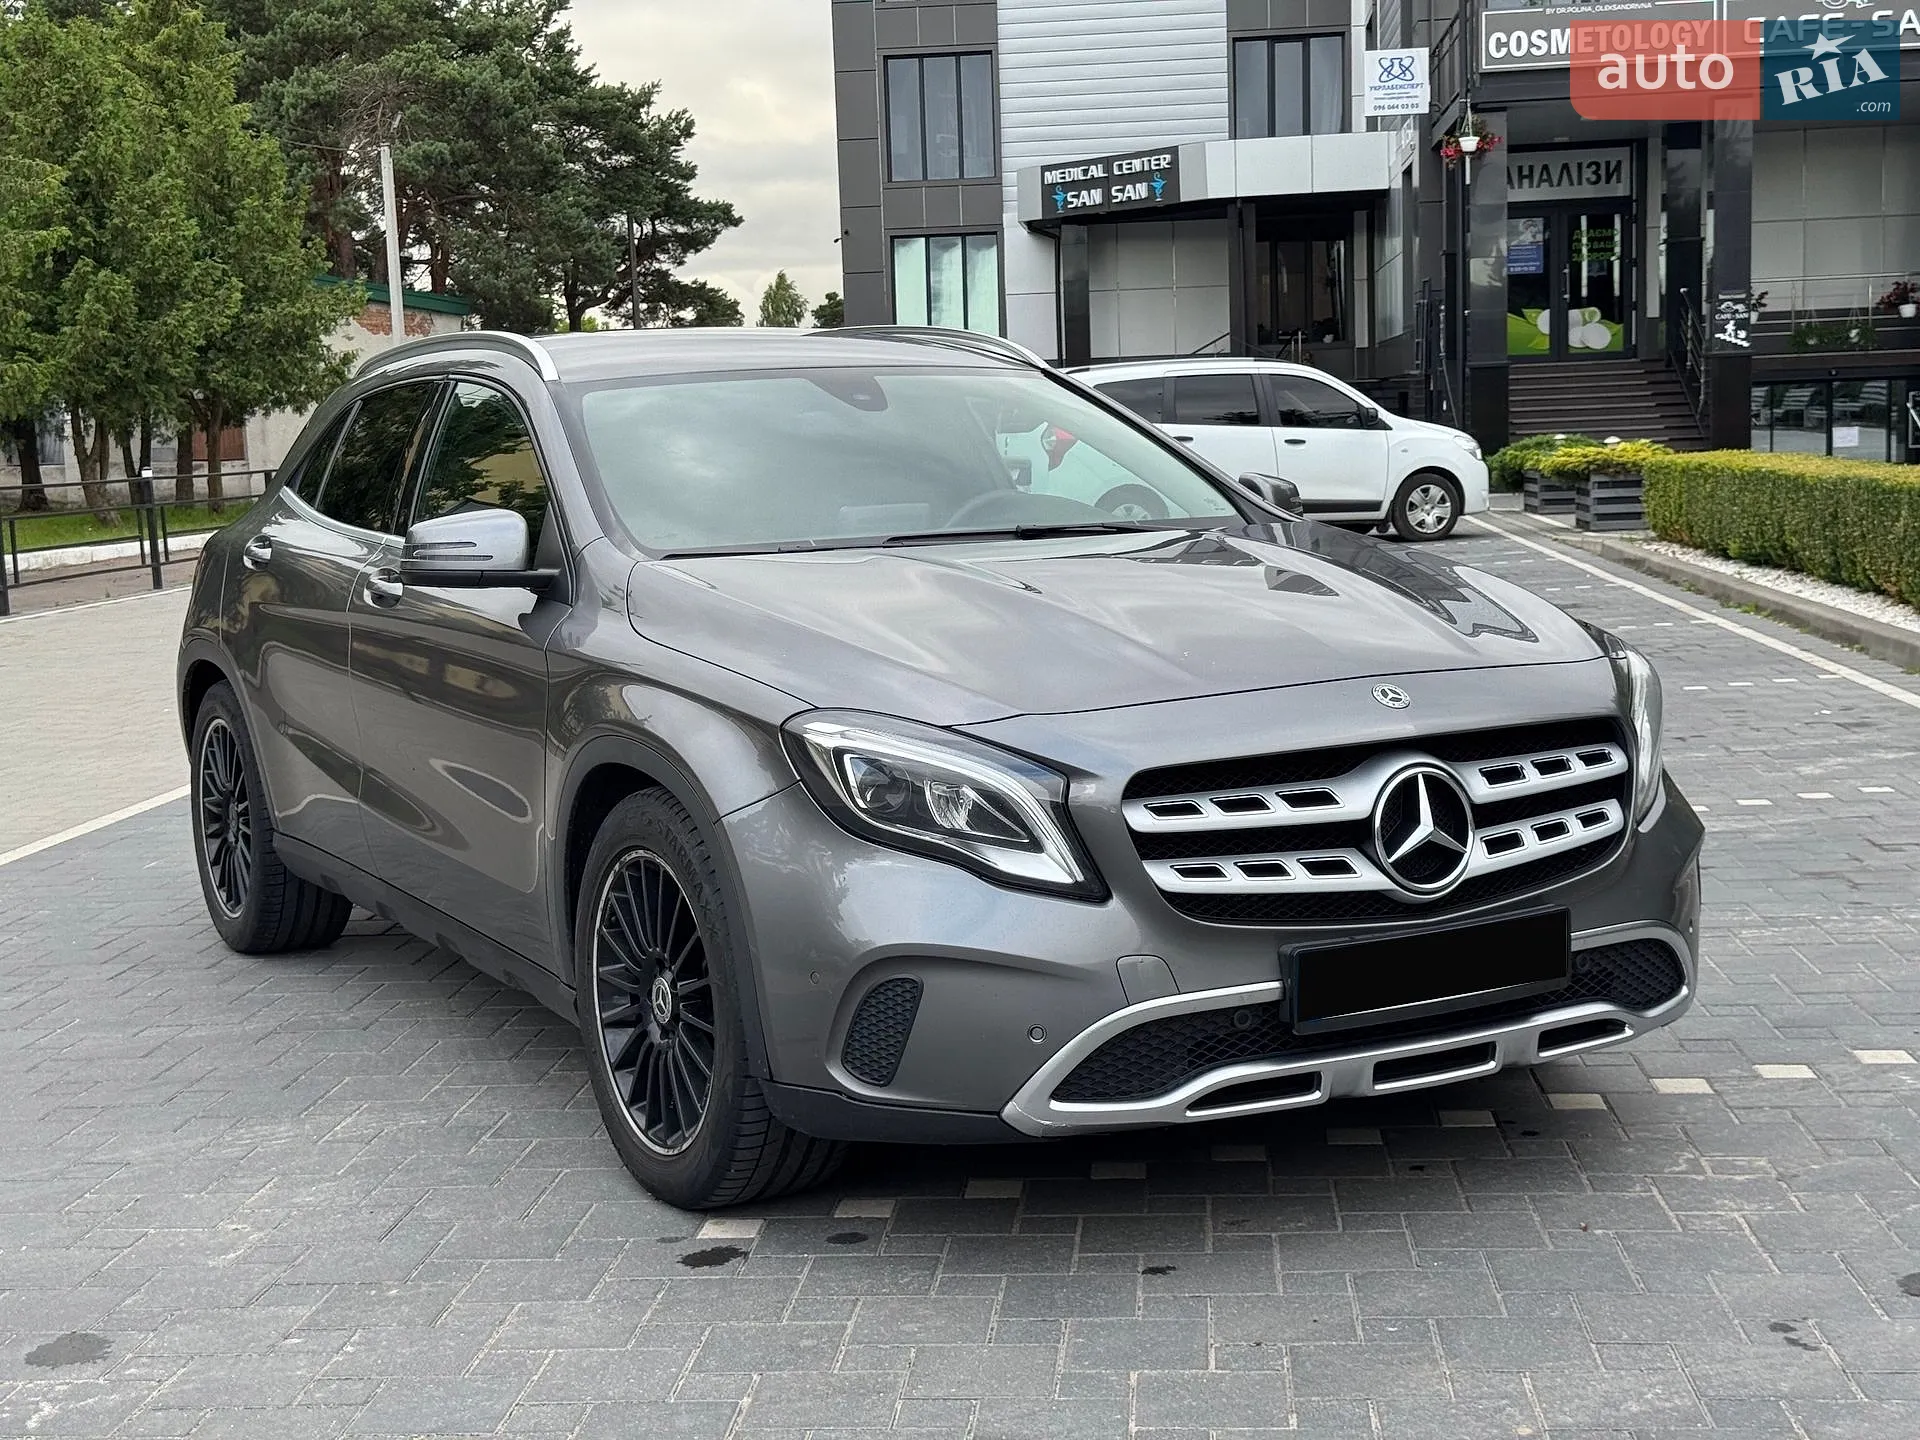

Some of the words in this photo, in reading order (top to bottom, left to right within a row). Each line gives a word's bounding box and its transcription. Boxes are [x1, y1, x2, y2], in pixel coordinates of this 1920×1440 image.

[1488, 20, 1712, 59] COSMETOLOGY
[1044, 164, 1108, 185] MEDICAL
[1113, 154, 1172, 175] CENTER
[1067, 188, 1103, 208] SAN
[1111, 182, 1149, 203] SAN
